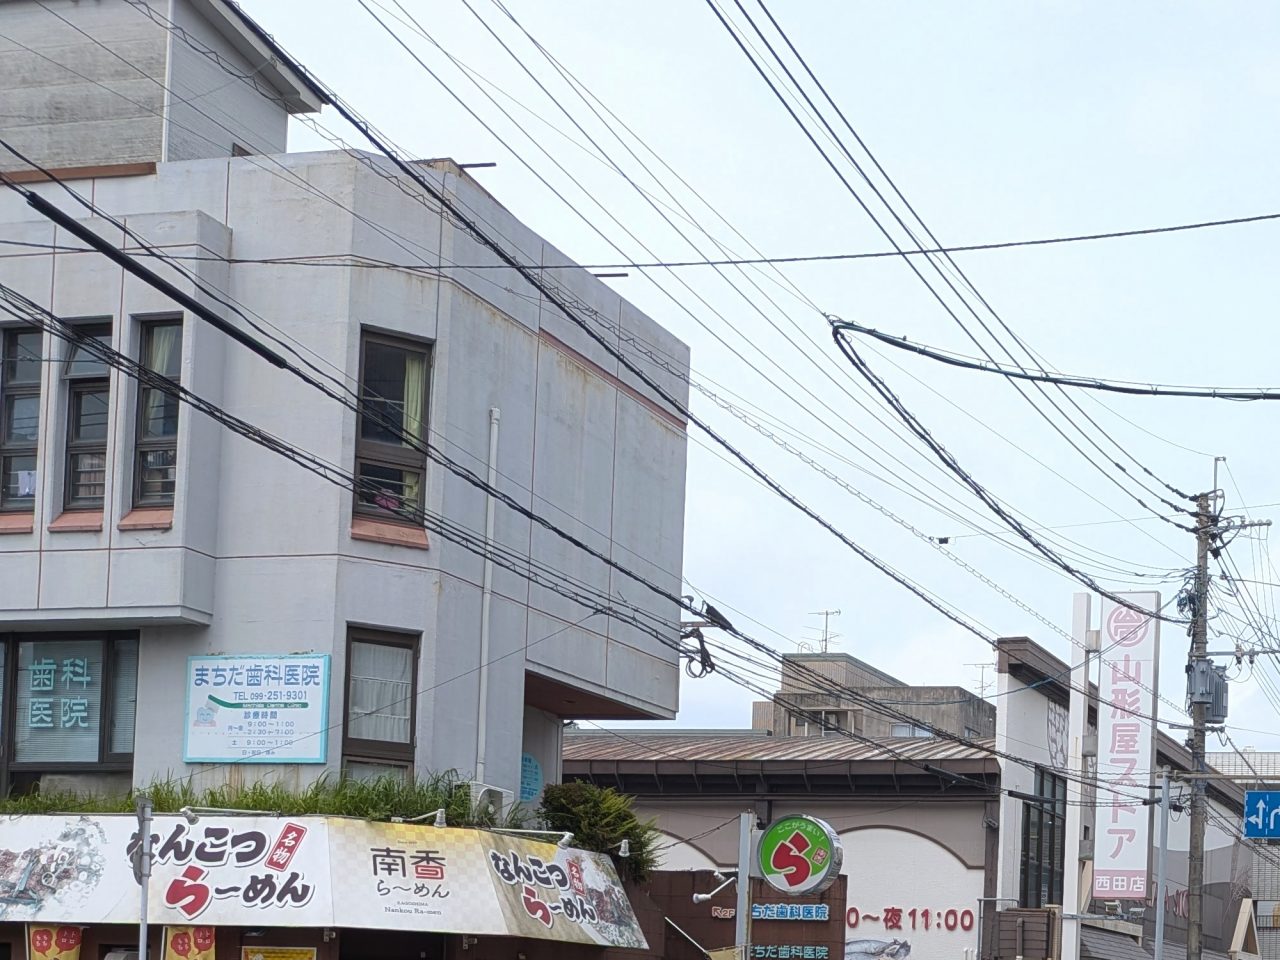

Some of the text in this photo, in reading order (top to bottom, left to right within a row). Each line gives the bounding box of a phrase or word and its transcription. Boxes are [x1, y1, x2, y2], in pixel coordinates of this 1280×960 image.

[28, 657, 92, 690] 歯科
[194, 663, 321, 687] まちだ歯科医院
[28, 695, 89, 729] 医院
[233, 691, 249, 701] TEL
[1108, 653, 1142, 860] 山形屋ストア
[272, 830, 297, 865] 名物
[370, 846, 447, 880] 南香
[770, 830, 812, 888] ら
[490, 850, 568, 888] なんこつ
[1095, 875, 1145, 892] 西田店
[165, 865, 312, 916] らーめん
[522, 885, 597, 928] らーめん
[384, 906, 413, 914] Nankou
[722, 908, 735, 919] 2F
[751, 903, 829, 920] ちだ歯科医院
[749, 945, 829, 959] ちだ歯科医院
